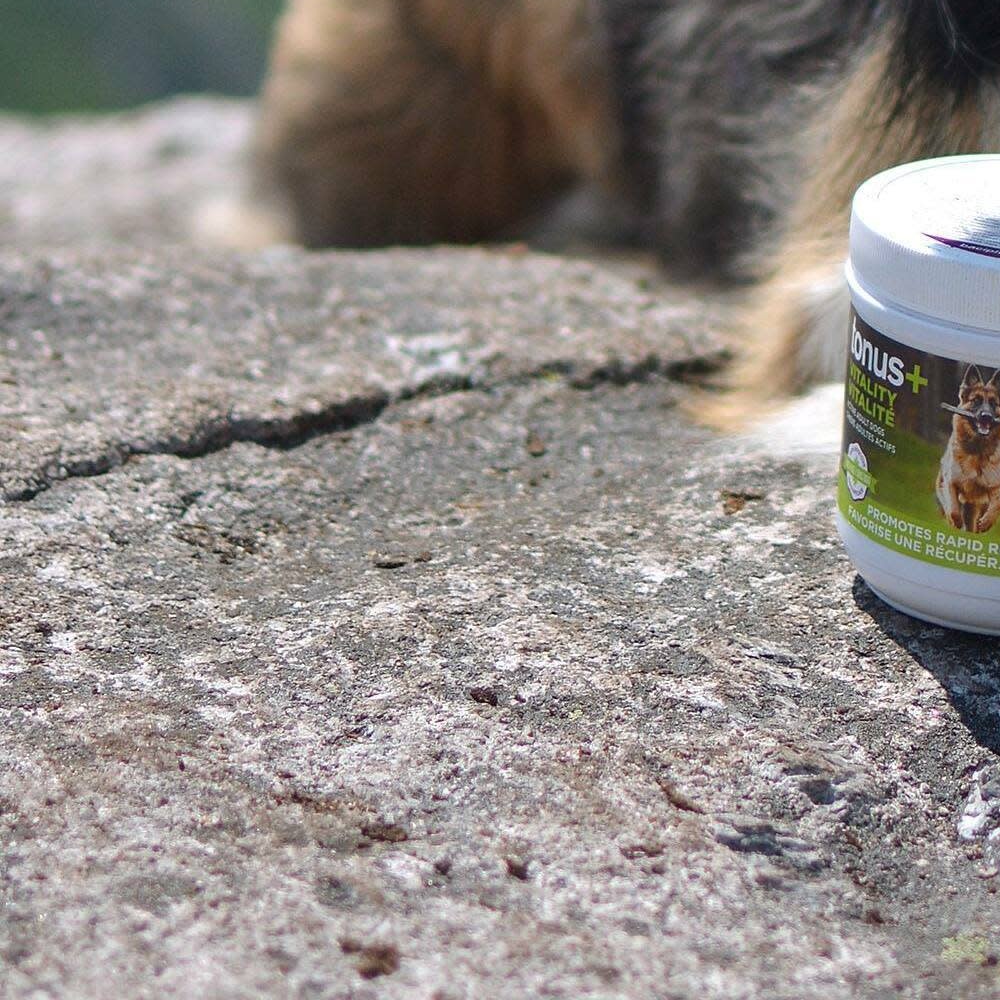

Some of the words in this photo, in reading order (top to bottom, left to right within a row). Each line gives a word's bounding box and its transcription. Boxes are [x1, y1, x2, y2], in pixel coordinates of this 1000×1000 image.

[874, 437, 897, 454] ACTIFS
[848, 504, 892, 541] FAVORISE
[894, 533, 922, 552] UNE
[867, 504, 932, 541] PROMOTES
[936, 532, 983, 552] RAPID
